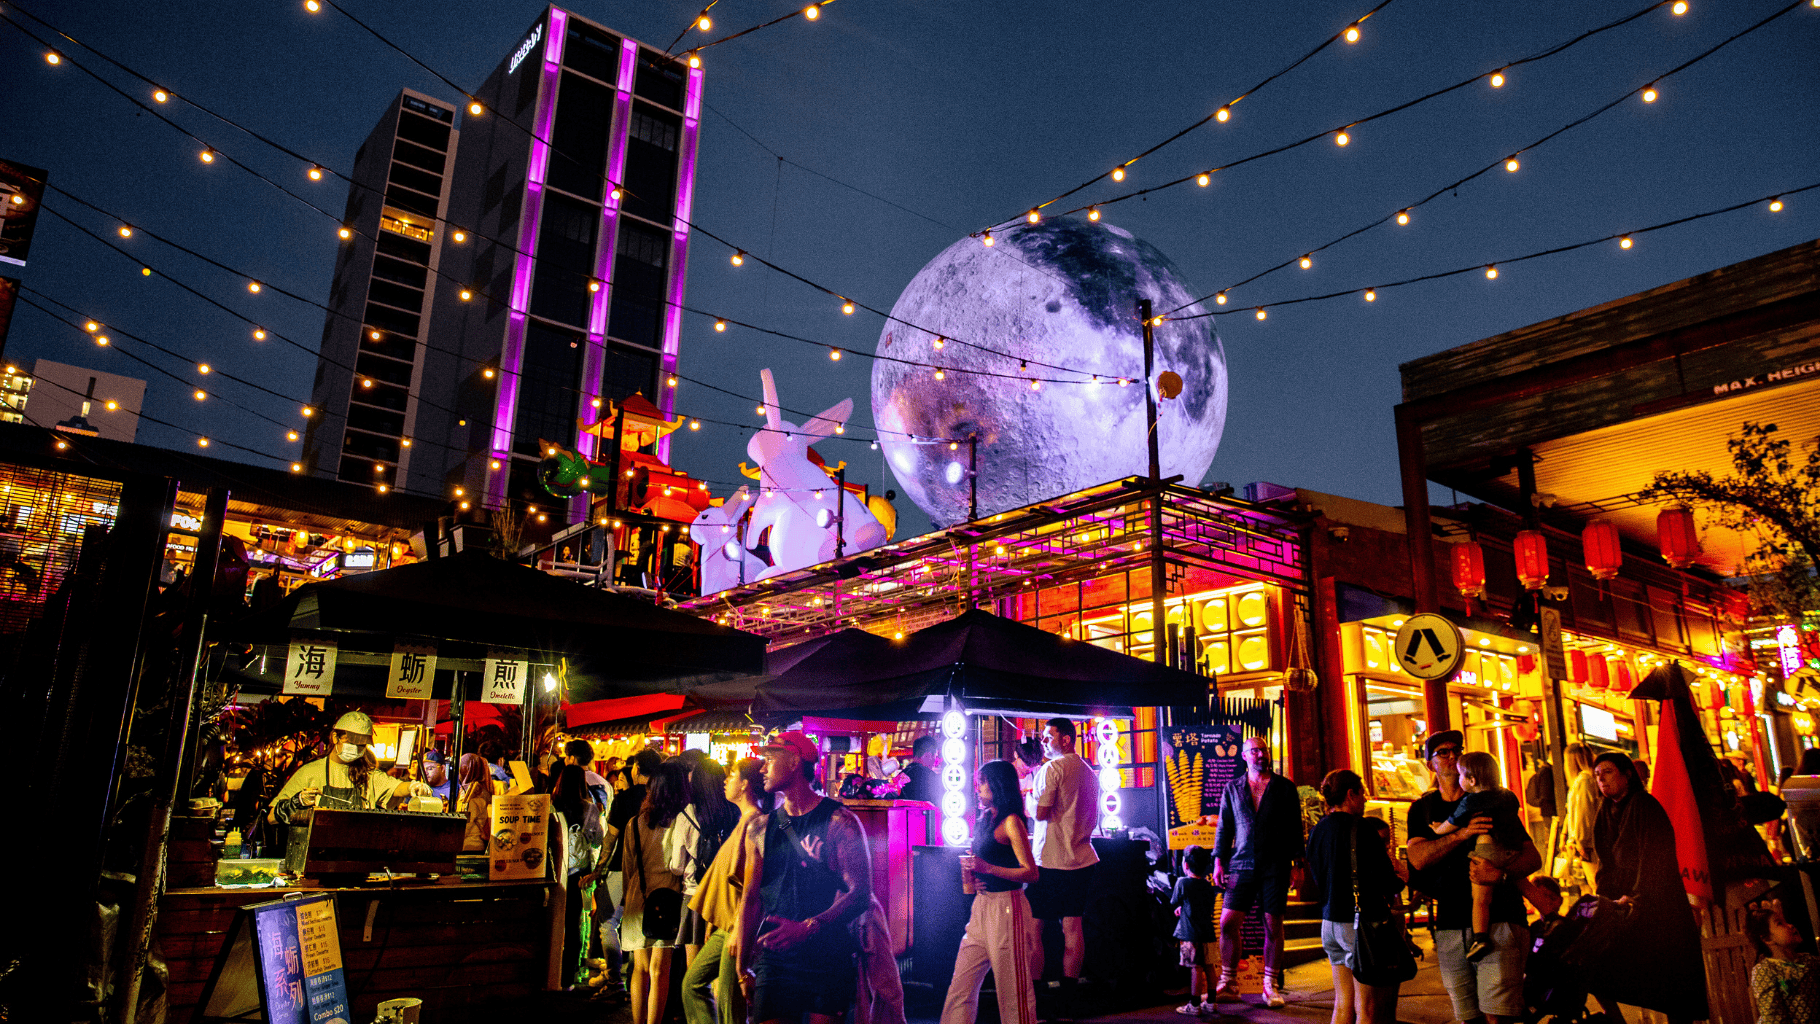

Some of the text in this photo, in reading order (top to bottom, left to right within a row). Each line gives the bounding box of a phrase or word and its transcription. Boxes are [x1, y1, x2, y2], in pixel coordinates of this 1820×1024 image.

[1713, 376, 1763, 395] MAX.
[294, 645, 327, 680] 海
[398, 651, 427, 684] 蛎
[494, 659, 518, 690] 煎
[293, 680, 321, 691] Yummy
[499, 815, 541, 824] SOUP TIME
[313, 1009, 334, 1021] Combo
[333, 1004, 344, 1015] $20
